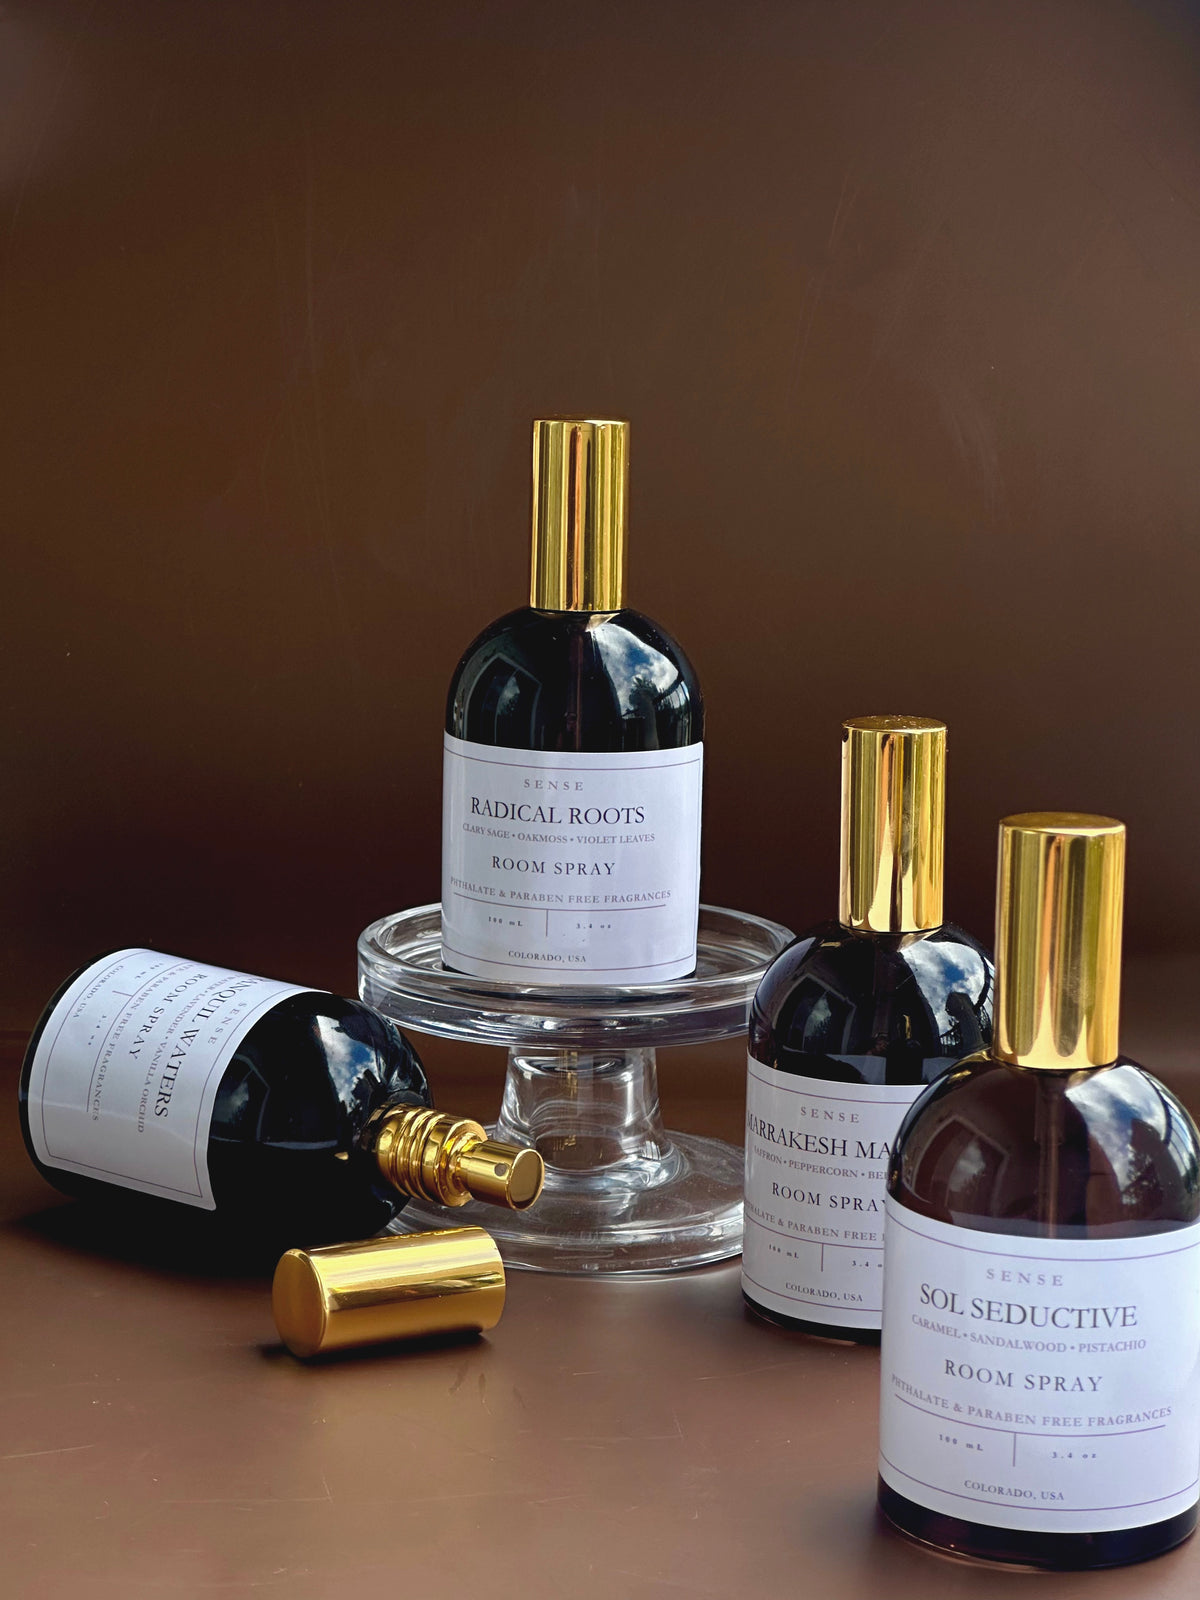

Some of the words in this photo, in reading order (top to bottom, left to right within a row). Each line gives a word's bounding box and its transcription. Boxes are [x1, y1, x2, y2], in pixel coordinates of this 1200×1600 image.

[524, 779, 584, 791] SENSE
[471, 796, 562, 824] RADICAL
[568, 806, 645, 824] ROOTS
[462, 823, 486, 835] CLARY
[486, 828, 510, 839] SAGE
[518, 833, 568, 844] OAKMOSS
[576, 836, 616, 844] VIOLET
[619, 834, 655, 844] LEAVES
[492, 856, 545, 874] ROOM
[554, 862, 616, 876] SPRAY
[450, 876, 496, 896] PHTHALATE
[499, 890, 506, 898] &
[510, 890, 564, 903] PARABEN
[568, 895, 600, 904] FREE
[604, 890, 672, 903] FRAGRANCES
[508, 951, 564, 963] COLORADO,
[568, 955, 586, 963] USA
[162, 973, 208, 1003] ROOM
[112, 1012, 132, 1040] FREE
[128, 1007, 164, 1060] SPRAY
[208, 1002, 247, 1044] SENSE
[144, 1042, 167, 1087] VANILLA
[154, 1028, 200, 1118] WATERS
[92, 1042, 116, 1121] FRAGRANCES
[137, 1089, 151, 1133] ORCHID
[800, 1106, 860, 1124] SENSE
[747, 1110, 848, 1157] MARRAKESH
[788, 1160, 858, 1178] PEPPERCORN
[772, 1182, 820, 1206] ROOM
[778, 1218, 784, 1226] &
[788, 1220, 840, 1238] PARABEN
[844, 1230, 877, 1241] FREE
[986, 1268, 1064, 1286] SENSE
[785, 1282, 840, 1300] COLORADO,
[844, 1293, 863, 1302] USA
[920, 1283, 964, 1315] SOL
[970, 1298, 1138, 1329] SEDUCTIVE
[912, 1314, 961, 1339] CARAMEL
[970, 1332, 1066, 1353] SANDALWOOD
[1078, 1339, 1146, 1353] PISTACHIO
[944, 1359, 1012, 1388] ROOM
[1024, 1374, 1103, 1392] SPRAY
[892, 1374, 949, 1409] PHTHALATE
[953, 1403, 963, 1413] &
[968, 1406, 1036, 1425] PARABEN
[1042, 1416, 1082, 1428] FREE
[1088, 1406, 1172, 1426] FRAGRANCES
[939, 1434, 958, 1445] 100
[966, 1442, 984, 1452] mL
[1052, 1451, 1073, 1459] 3.4
[964, 1480, 1036, 1500] COLORADO,
[1041, 1490, 1064, 1500] USA
